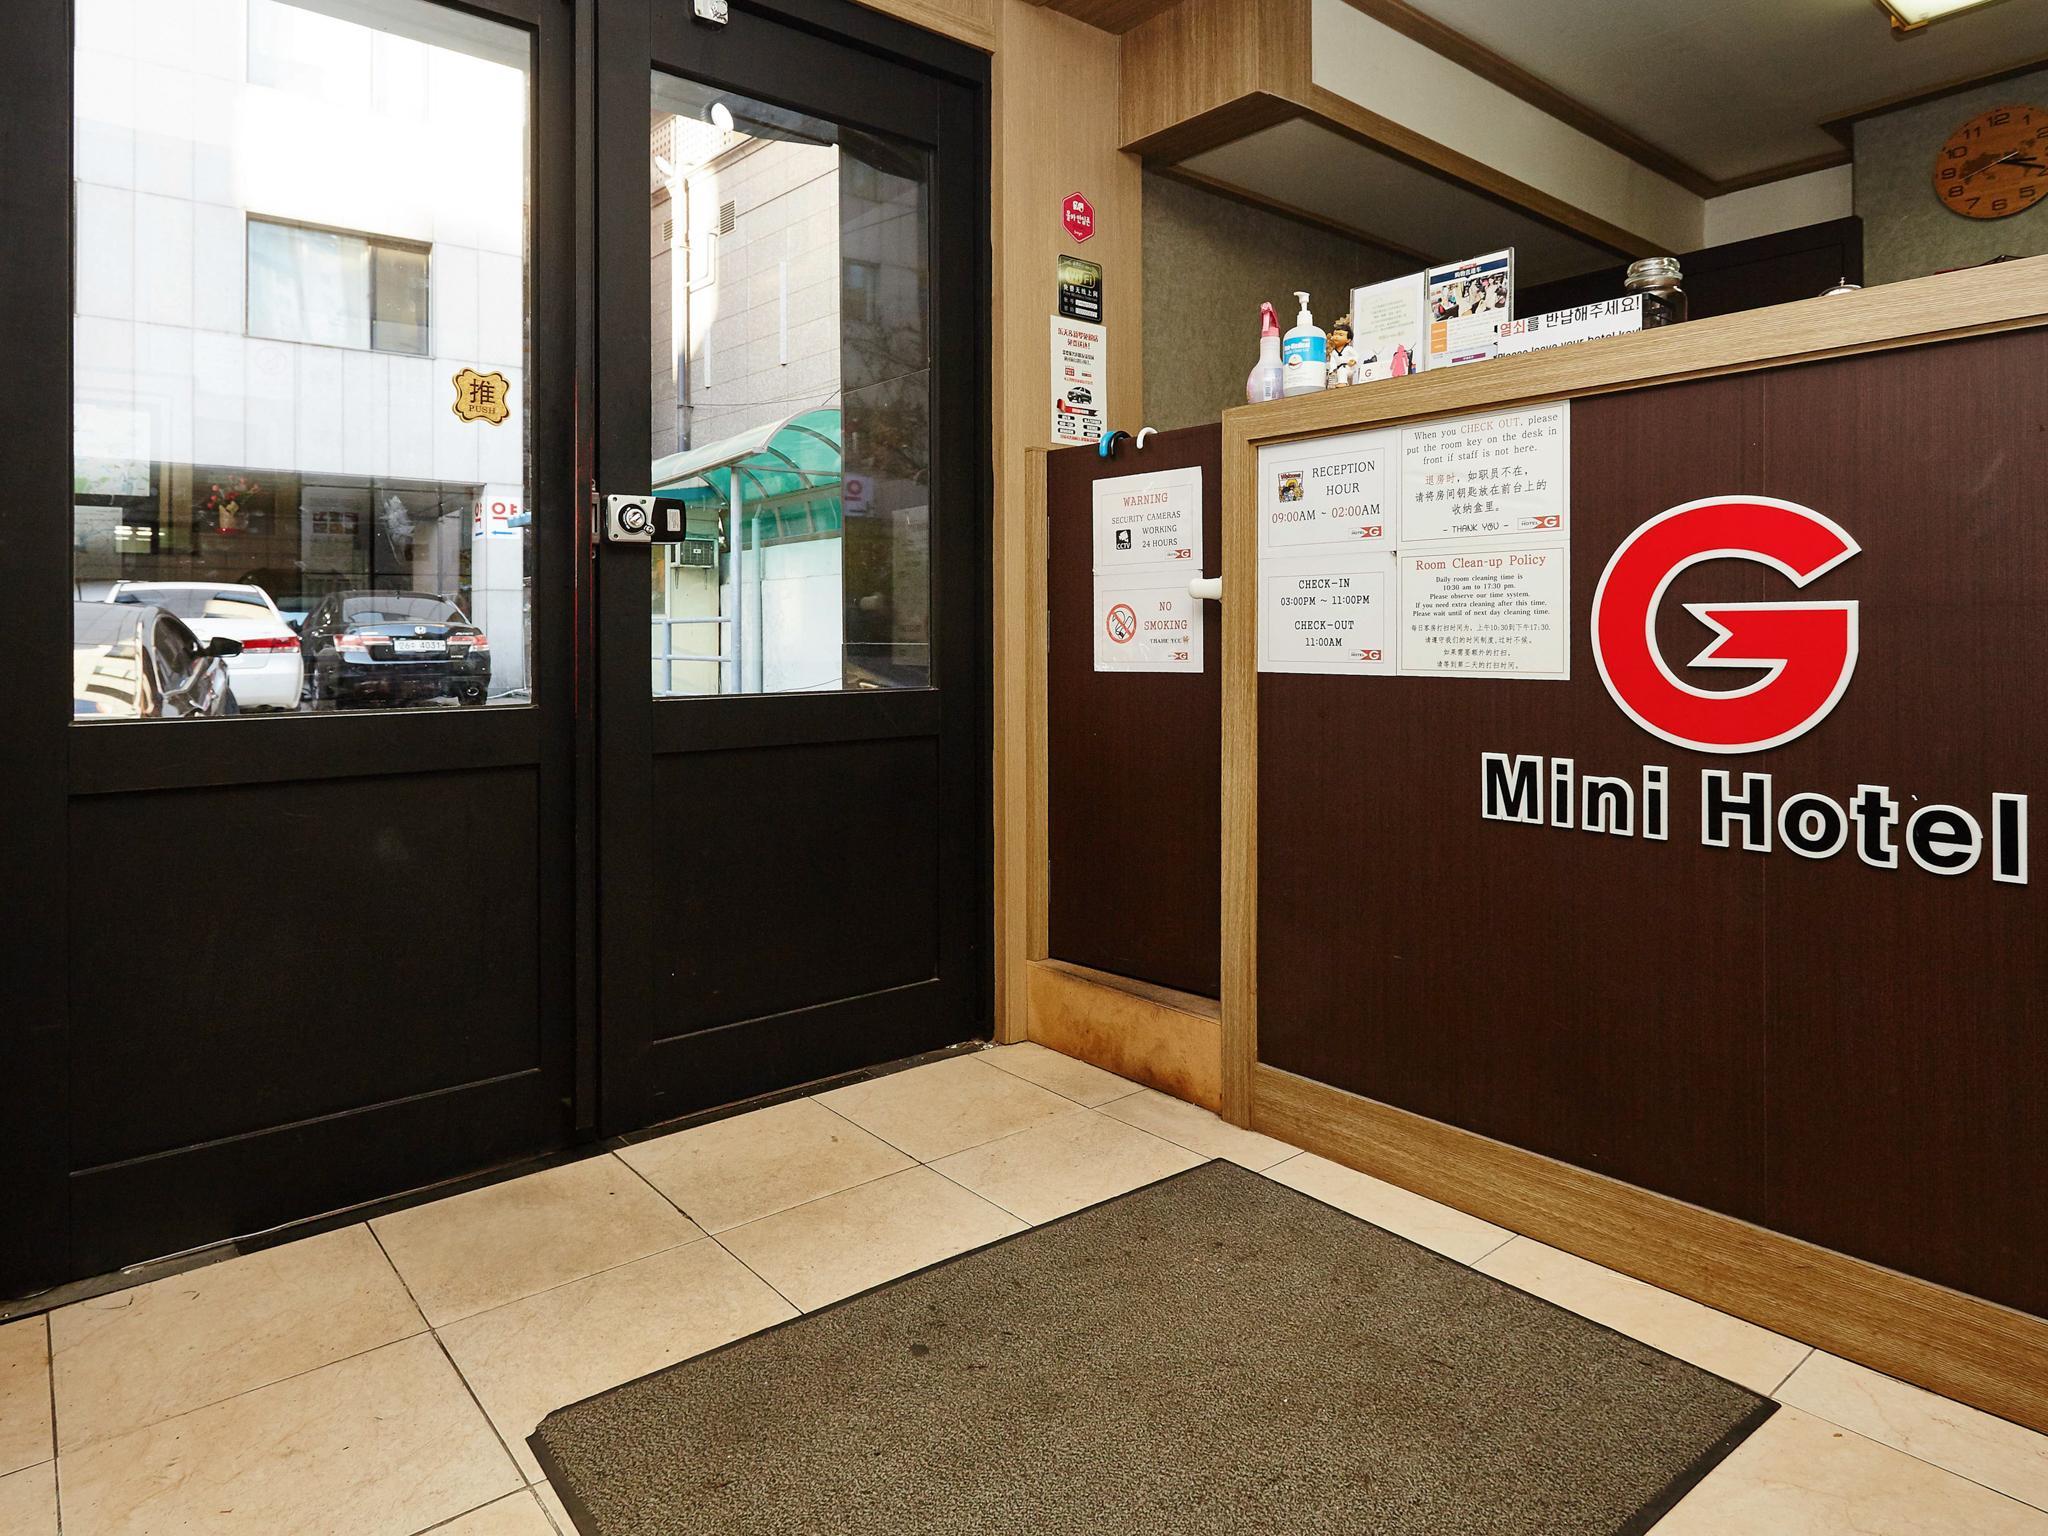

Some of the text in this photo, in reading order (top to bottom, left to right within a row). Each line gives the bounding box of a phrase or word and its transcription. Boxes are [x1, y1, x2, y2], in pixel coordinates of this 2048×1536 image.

[1988, 112, 2010, 127] 12
[2023, 114, 2030, 125] 1
[1963, 126, 1981, 139] 11
[1946, 146, 1968, 159] 10
[1941, 167, 1956, 180] 9
[1948, 185, 1964, 198] 8
[2019, 185, 2035, 198] 5
[1965, 197, 1980, 210] 7
[1991, 199, 2008, 211] 6
[1500, 317, 1540, 338] 열쇠를
[1546, 296, 1640, 328] 반납해주세요!
[470, 378, 496, 404] 推
[468, 404, 496, 414] PUSH
[1414, 432, 1437, 440] When
[1441, 429, 1456, 438] you
[1461, 421, 1493, 434] CHECK
[1529, 414, 1558, 425] please
[1407, 446, 1419, 455] put
[1424, 444, 1436, 452] the
[1441, 442, 1462, 450] room
[1467, 438, 1482, 447] key
[1503, 433, 1516, 442] the
[1522, 430, 1543, 439] desk
[1424, 445, 1537, 464] front if staff is not here.
[1312, 461, 1375, 478] RECEPTION
[1327, 483, 1360, 495] HOUR
[1123, 493, 1168, 506] WARNING
[1112, 511, 1180, 524] SECURITY CAMERAS
[1272, 510, 1316, 523] 09:00AM
[1332, 504, 1380, 518] 02:00AM
[1452, 522, 1499, 533] THANK YOU
[1544, 517, 1556, 527] G
[1142, 525, 1177, 534] WORKING
[1369, 527, 1380, 536] G
[1153, 538, 1178, 547] HOURS
[1416, 554, 1546, 570] Room Clean-up Policy
[1299, 578, 1350, 589] CHECK-IN
[1160, 602, 1172, 611] NO
[1281, 597, 1316, 606] 03:00PM
[1332, 595, 1370, 604] 11:00PM
[1490, 609, 1500, 617] day
[1504, 608, 1530, 616] cleaning
[1144, 620, 1187, 630] SMOKING
[1295, 621, 1354, 630] CHECK-OUT
[1590, 495, 1862, 754] G
[1306, 638, 1342, 646] 11:00AM
[1369, 651, 1380, 659] G
[1481, 752, 2028, 884] Mini Hotel
